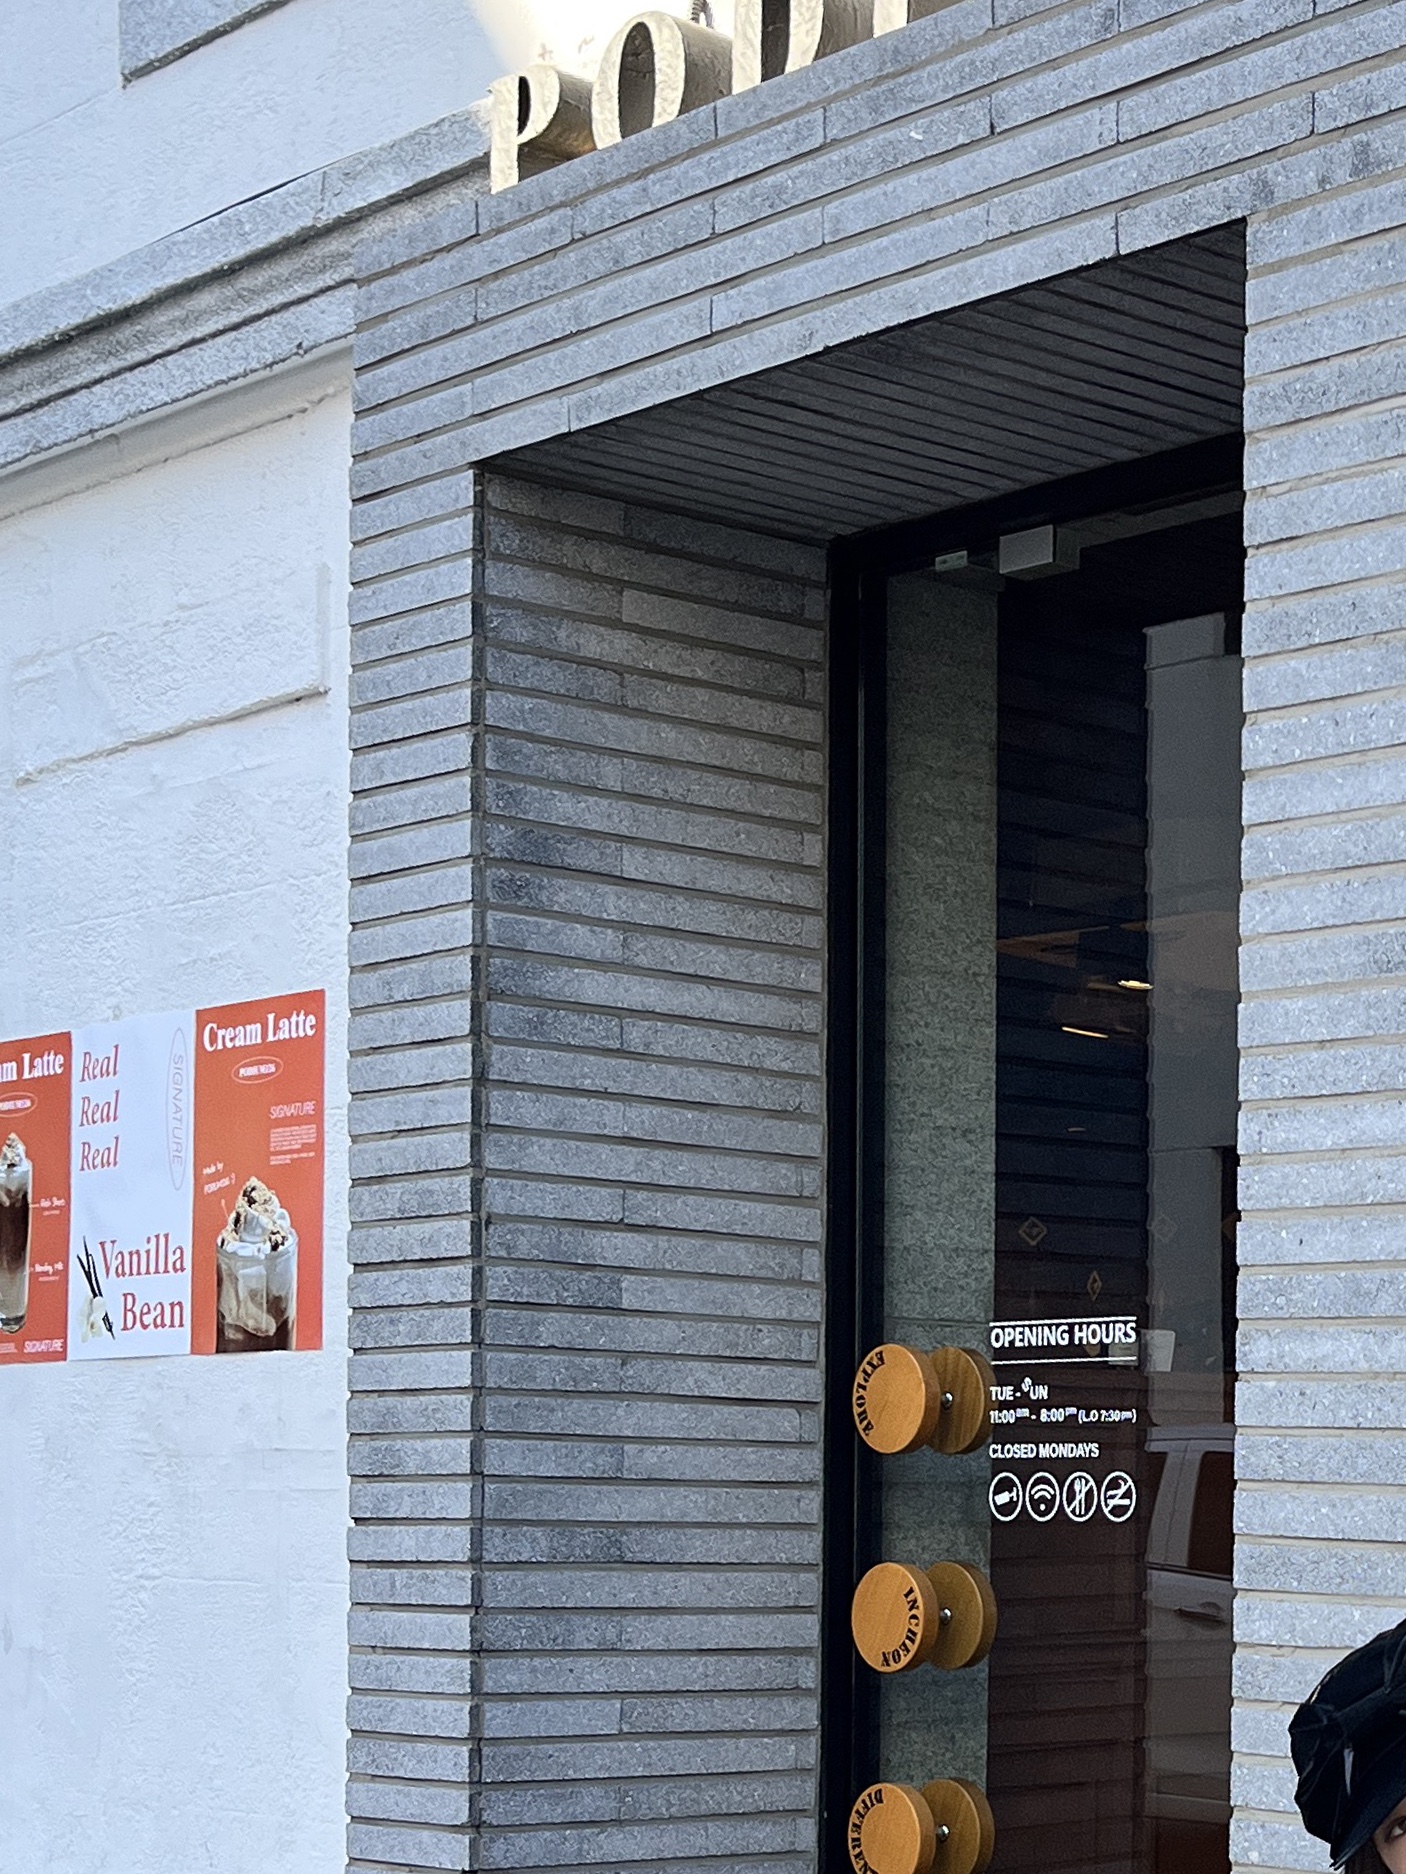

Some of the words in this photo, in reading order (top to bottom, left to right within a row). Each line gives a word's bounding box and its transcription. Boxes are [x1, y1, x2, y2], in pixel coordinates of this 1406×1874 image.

[203, 1022, 262, 1052] Cream
[266, 1009, 317, 1042] Latte
[21, 1049, 65, 1080] Latte
[79, 1043, 120, 1083] Real
[79, 1089, 120, 1128] Real
[172, 1053, 184, 1168] SIGNATURE
[269, 1100, 317, 1119] SIGNATURE
[79, 1134, 120, 1172] Real
[98, 1231, 187, 1280] Vanilla
[120, 1292, 185, 1332] Bean
[990, 1324, 1070, 1349] OPENING
[1073, 1322, 1137, 1346] HOURS
[989, 1443, 1037, 1459] CLOSED
[1038, 1442, 1100, 1458] MONDAYS
[880, 1586, 920, 1668] INCHEON
